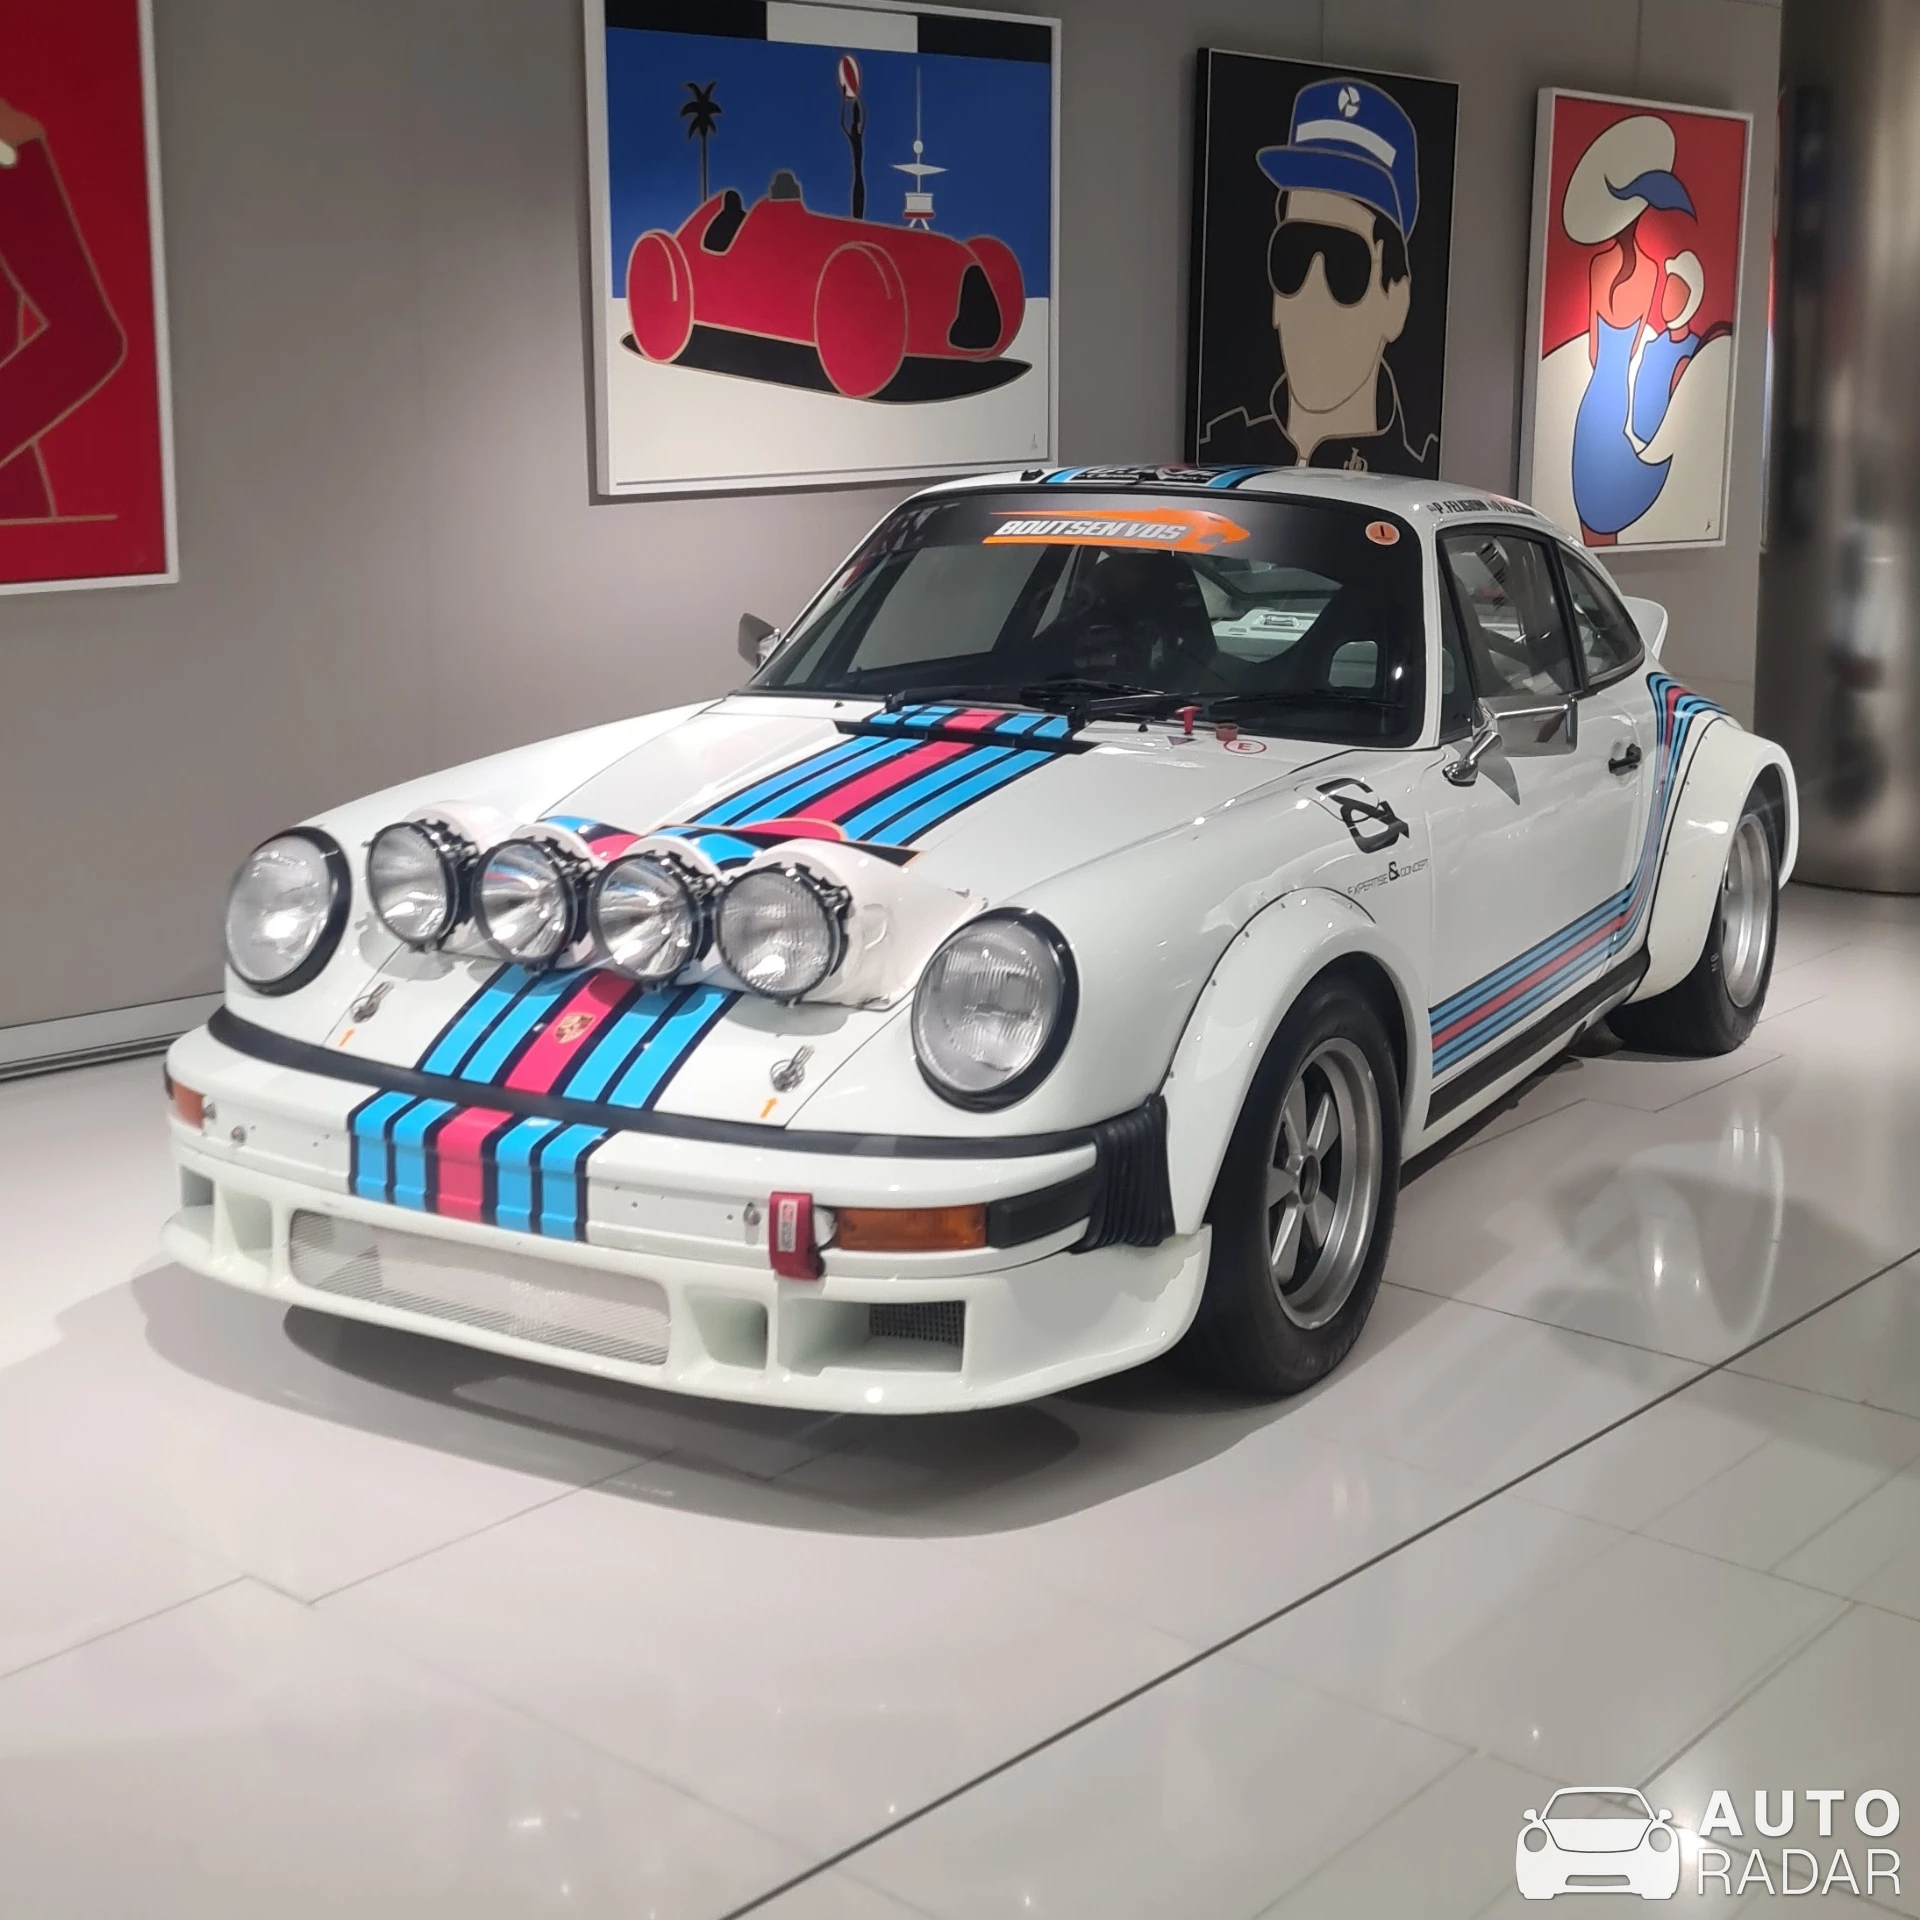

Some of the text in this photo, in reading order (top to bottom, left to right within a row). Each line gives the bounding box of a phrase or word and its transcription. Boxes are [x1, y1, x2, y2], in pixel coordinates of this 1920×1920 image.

[994, 520, 1187, 540] BOUTSEN VOS
[1237, 742, 1252, 751] E
